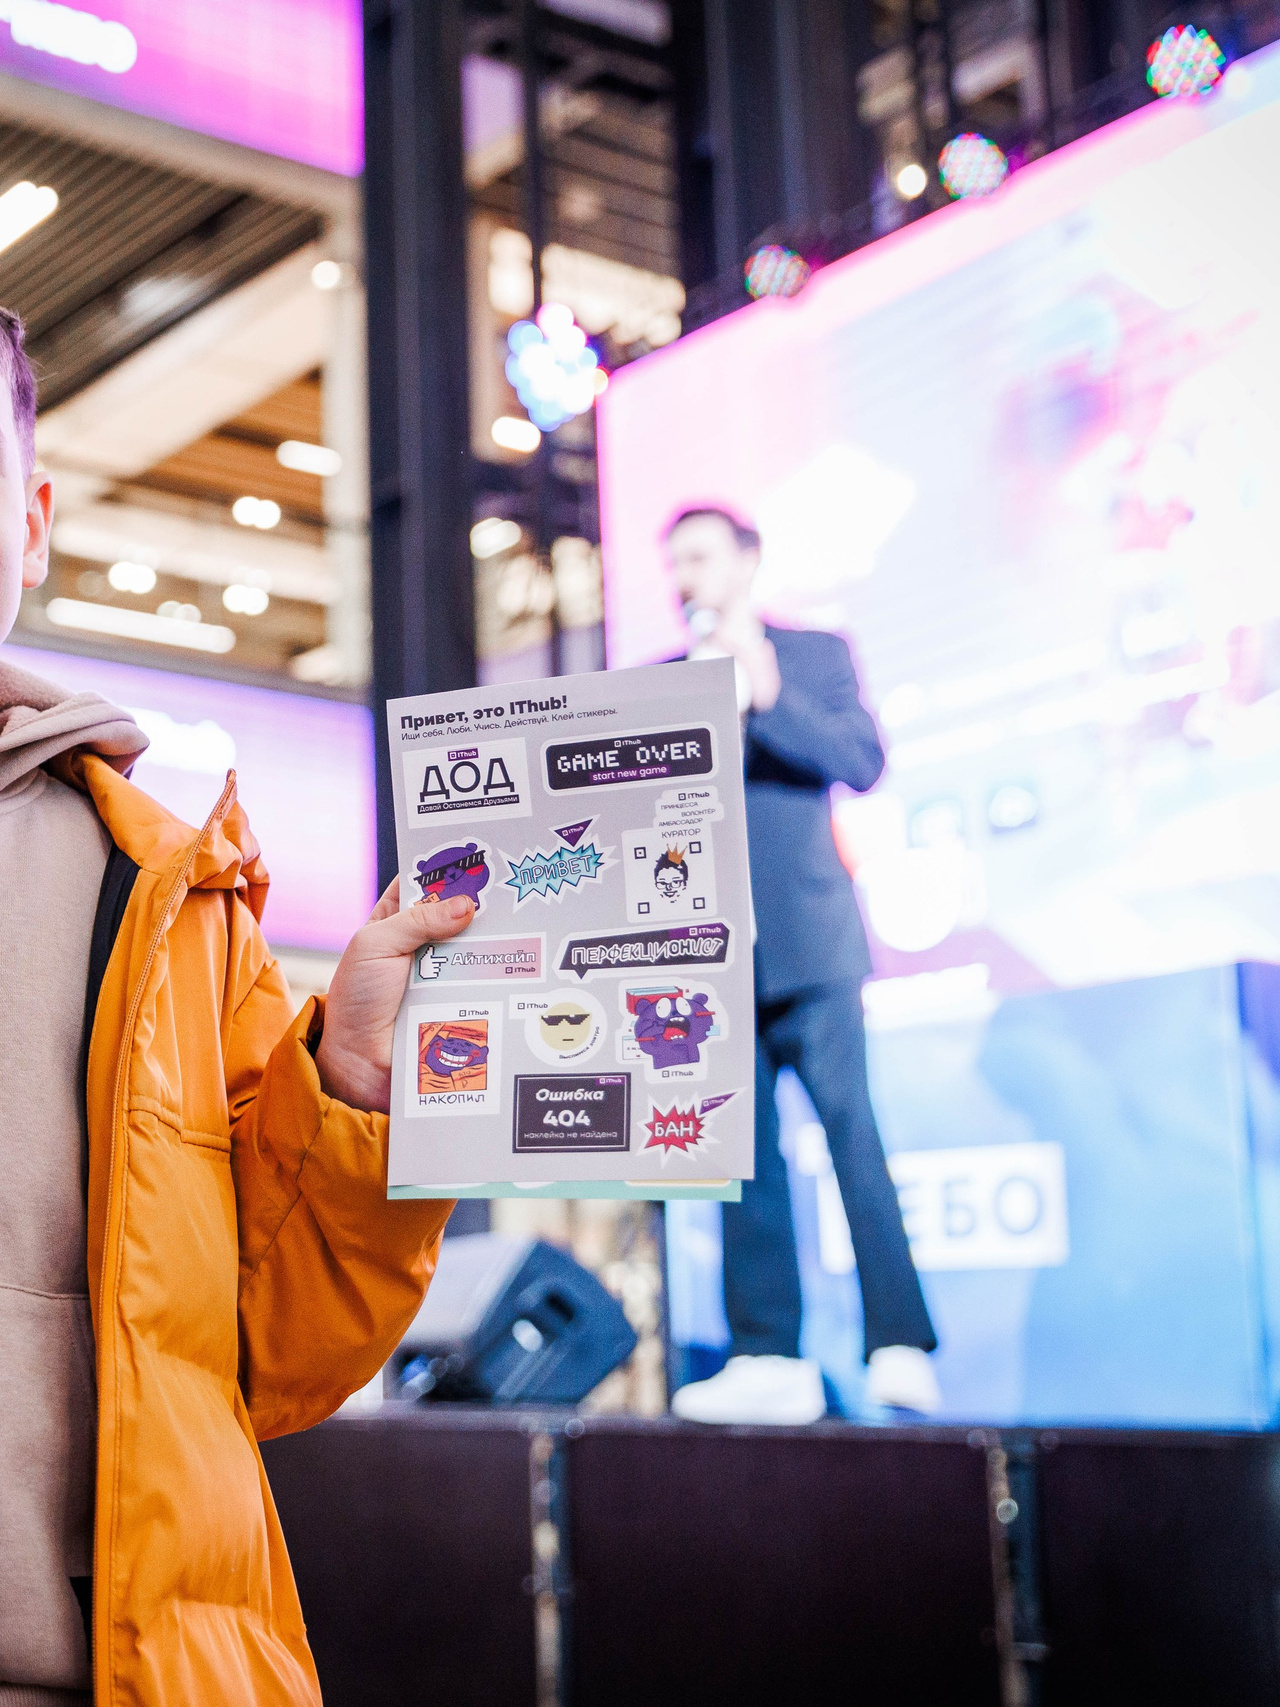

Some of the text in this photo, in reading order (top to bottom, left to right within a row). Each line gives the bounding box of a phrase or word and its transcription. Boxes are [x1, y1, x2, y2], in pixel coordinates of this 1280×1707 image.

[401, 695, 567, 730] Привет, это IThub!
[401, 708, 618, 741] Ищи себя. Люби. Учись. Действуй. Клей стикеры.
[457, 750, 477, 758] IThub
[557, 741, 701, 772] GAME OVER
[420, 757, 515, 802] ДОД
[592, 766, 667, 781] start new game
[687, 791, 710, 799] IThub
[420, 796, 517, 813] Давай Останемся Друзьями
[658, 818, 703, 826] АМБАССАДОР
[661, 828, 701, 838] КУРАТОР
[520, 855, 592, 885] ПРИВЕТ
[451, 950, 536, 966] Айтихайп
[572, 938, 723, 965] ПЕРФЕКЦИОНИСТ
[419, 1094, 485, 1105] НАКОПИЛ
[535, 1088, 605, 1101] Ошибка
[543, 1109, 591, 1127] 404
[654, 1122, 694, 1138] БАН
